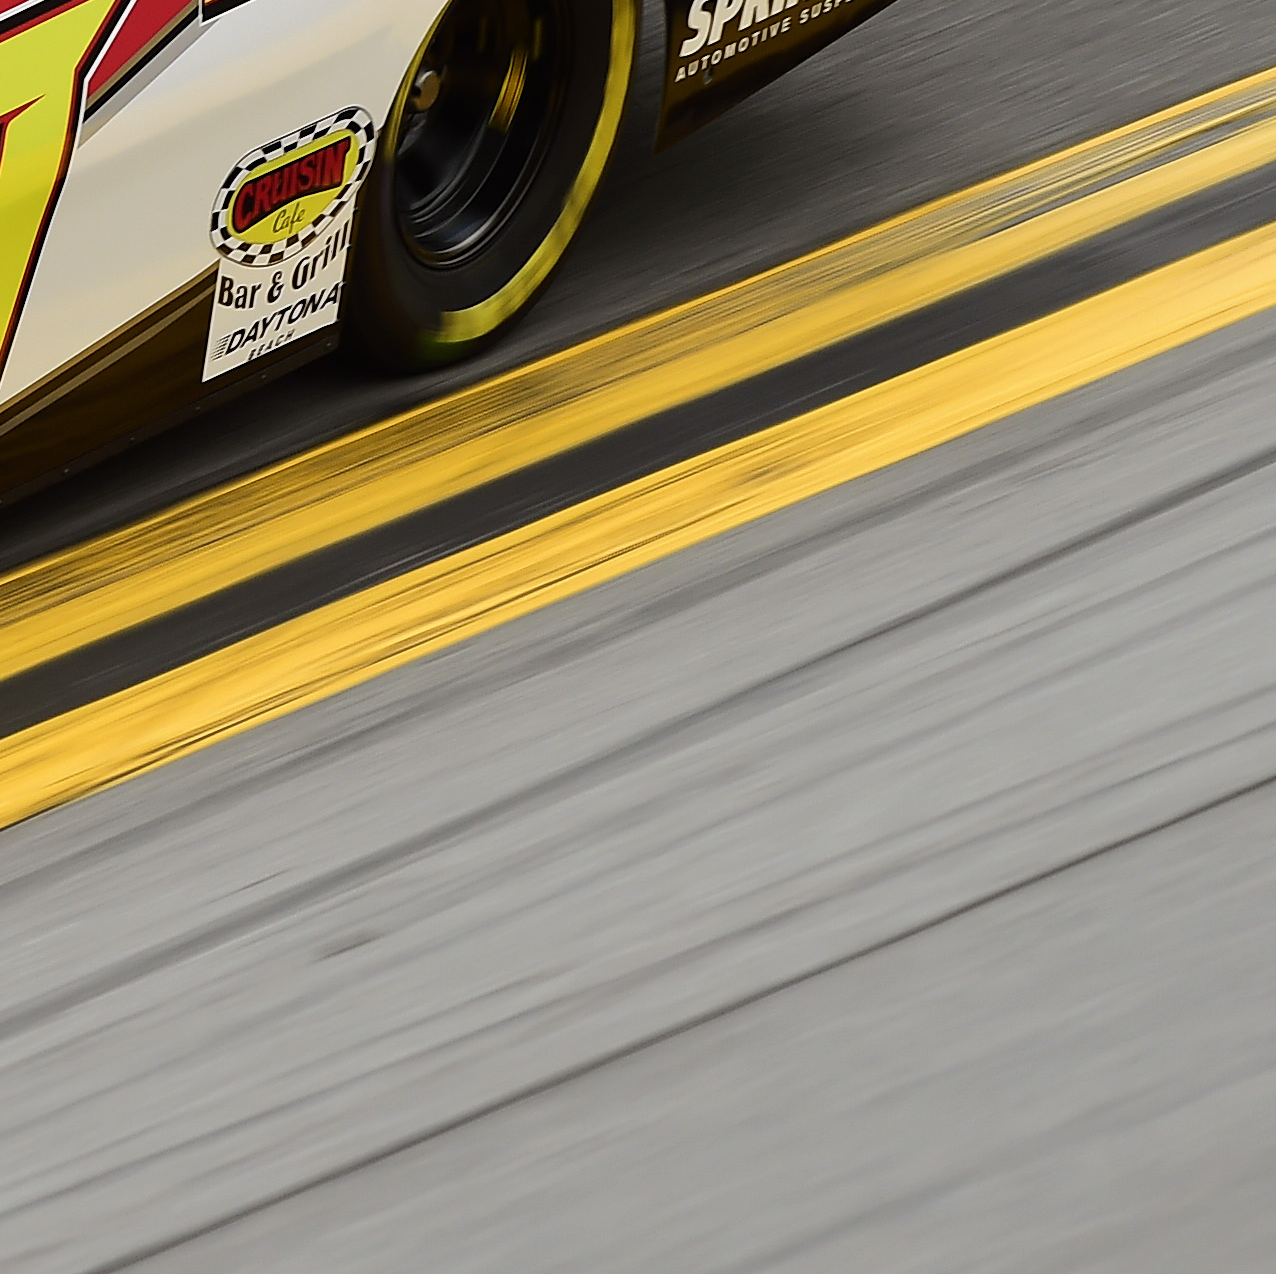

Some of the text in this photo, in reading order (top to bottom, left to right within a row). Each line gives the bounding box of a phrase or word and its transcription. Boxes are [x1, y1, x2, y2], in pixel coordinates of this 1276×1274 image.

[674, 16, 791, 83] AUTOMOTIVE
[218, 219, 350, 309] Bar & Grill
[225, 282, 340, 355] DAYTONA
[248, 328, 295, 361] BEACH
